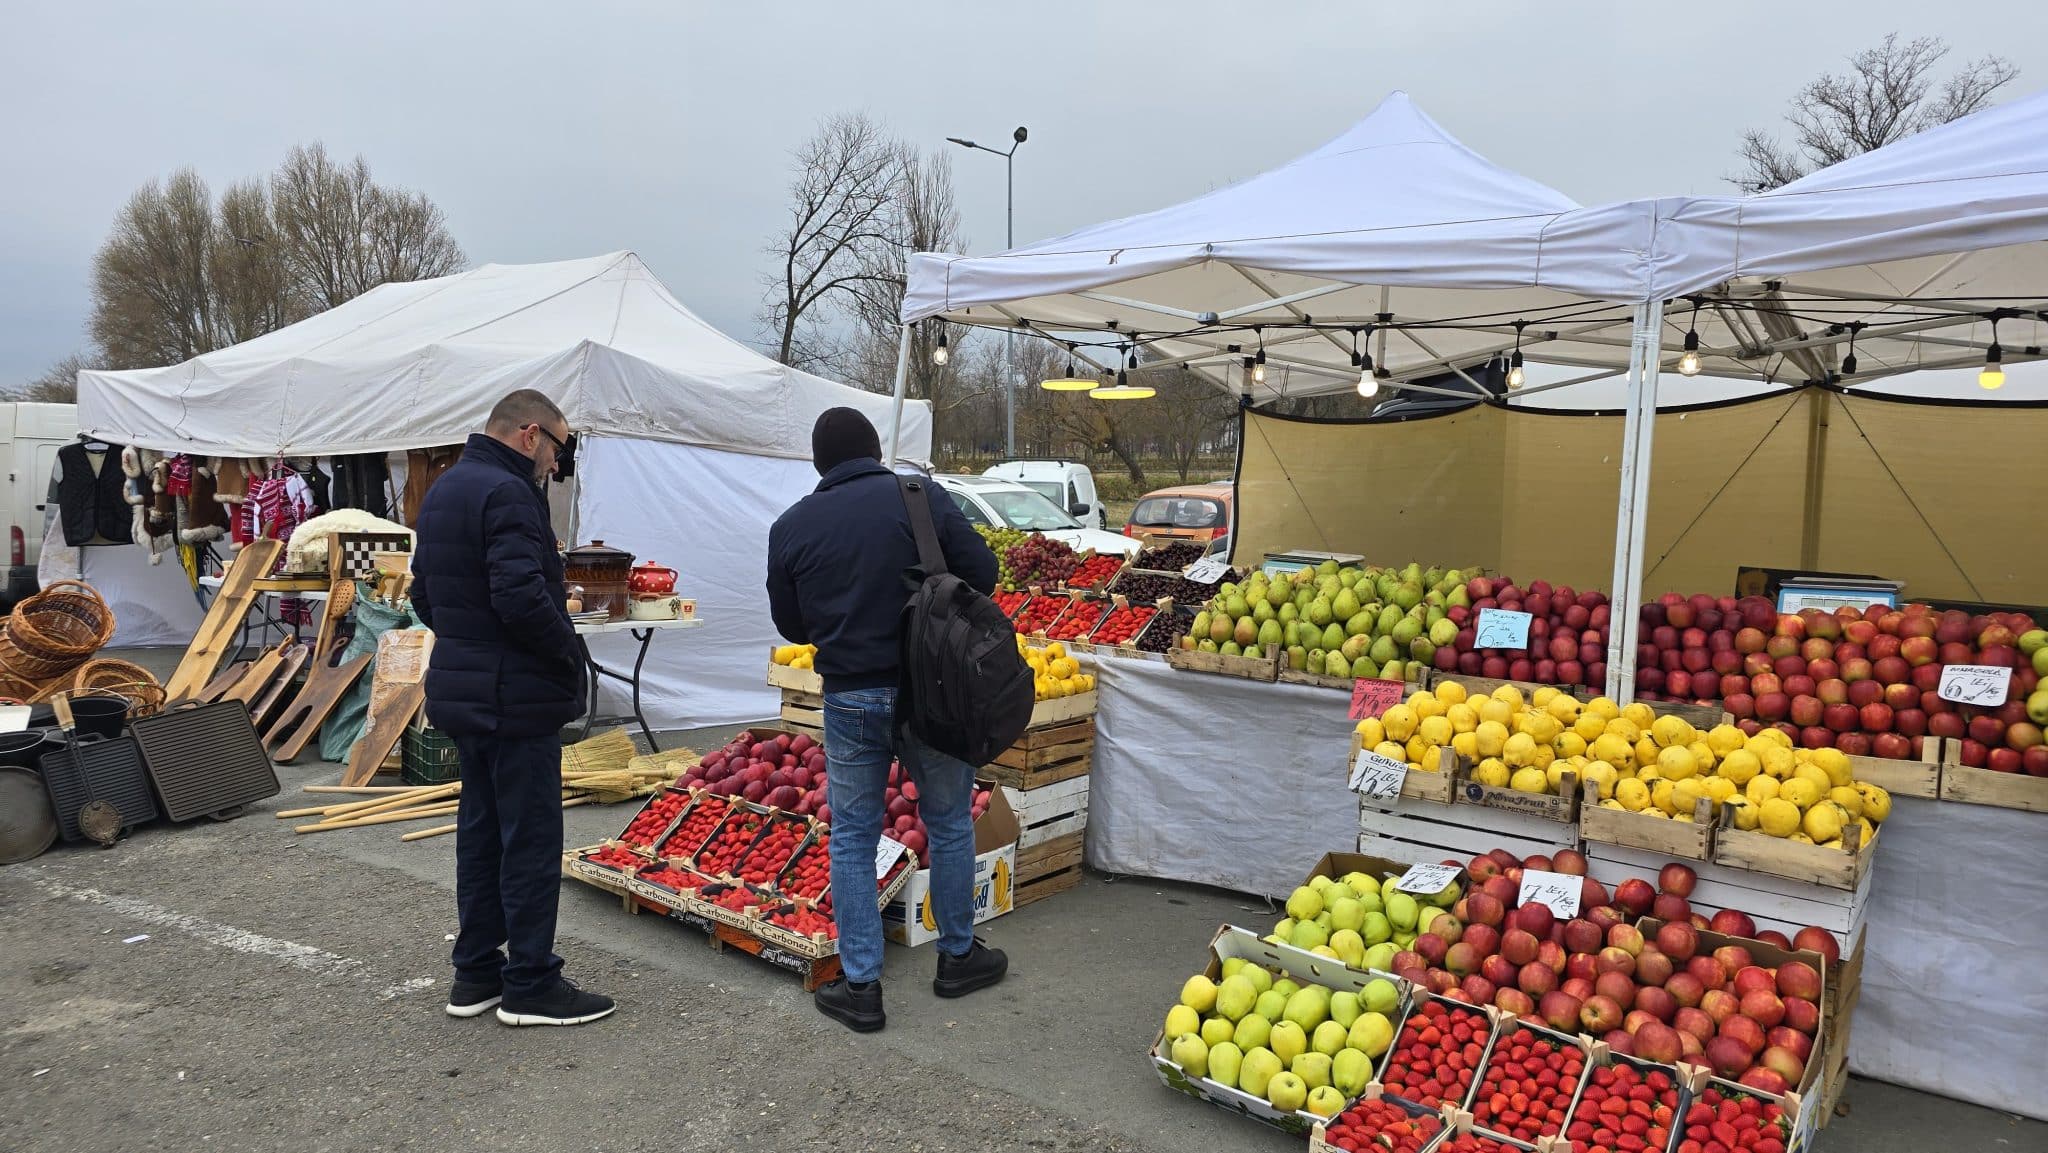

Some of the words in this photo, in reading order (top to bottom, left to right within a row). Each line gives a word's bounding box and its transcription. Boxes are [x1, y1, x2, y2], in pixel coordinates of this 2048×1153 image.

[580, 864, 625, 885] Carbonera
[636, 884, 681, 908] Carbonera
[878, 864, 916, 910] arbonera
[696, 904, 746, 926] Carbonera
[761, 927, 815, 953] Carbonera
